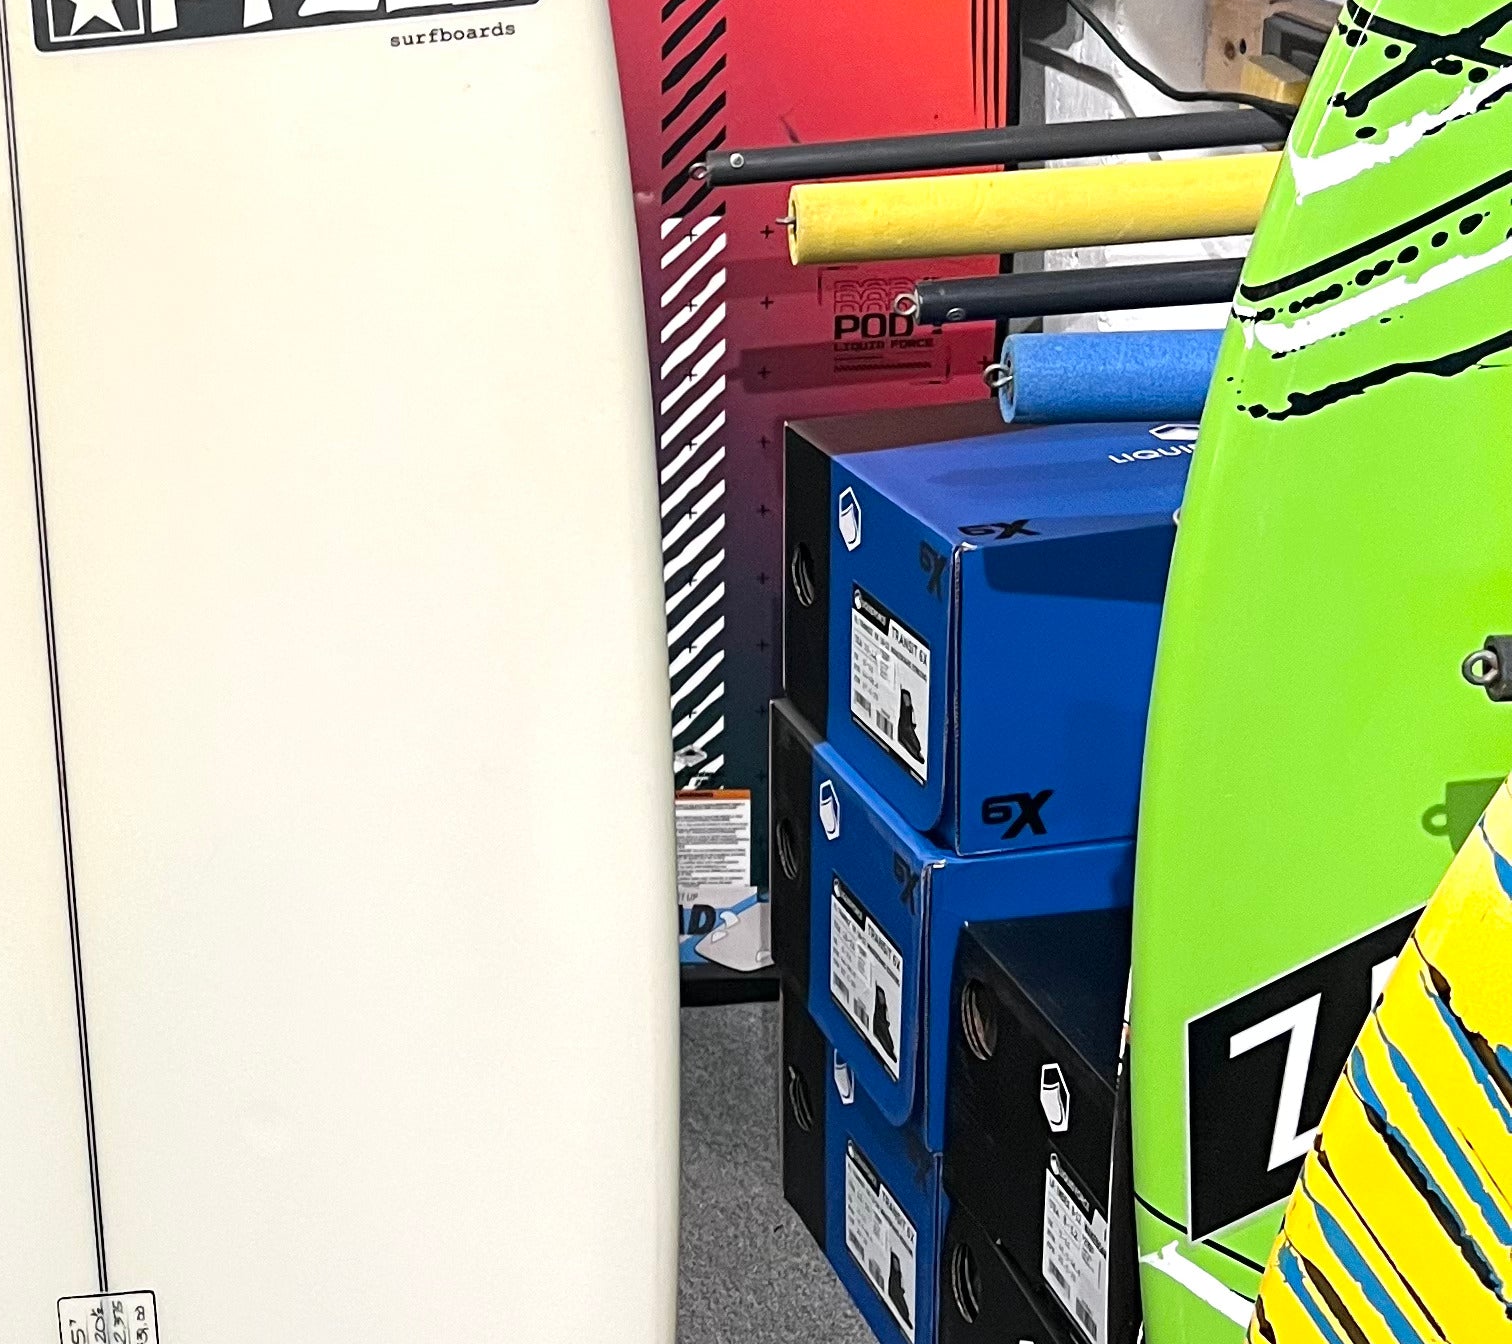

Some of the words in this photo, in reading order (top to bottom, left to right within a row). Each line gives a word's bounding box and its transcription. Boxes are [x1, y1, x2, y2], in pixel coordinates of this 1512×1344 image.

[389, 21, 517, 48] surfboards
[834, 312, 914, 340] POD
[833, 340, 885, 352] LIQUID
[890, 338, 934, 349] FORCE
[1108, 442, 1198, 464] LIQUI
[891, 626, 918, 658] TRANSIT
[981, 789, 1055, 841] 6X
